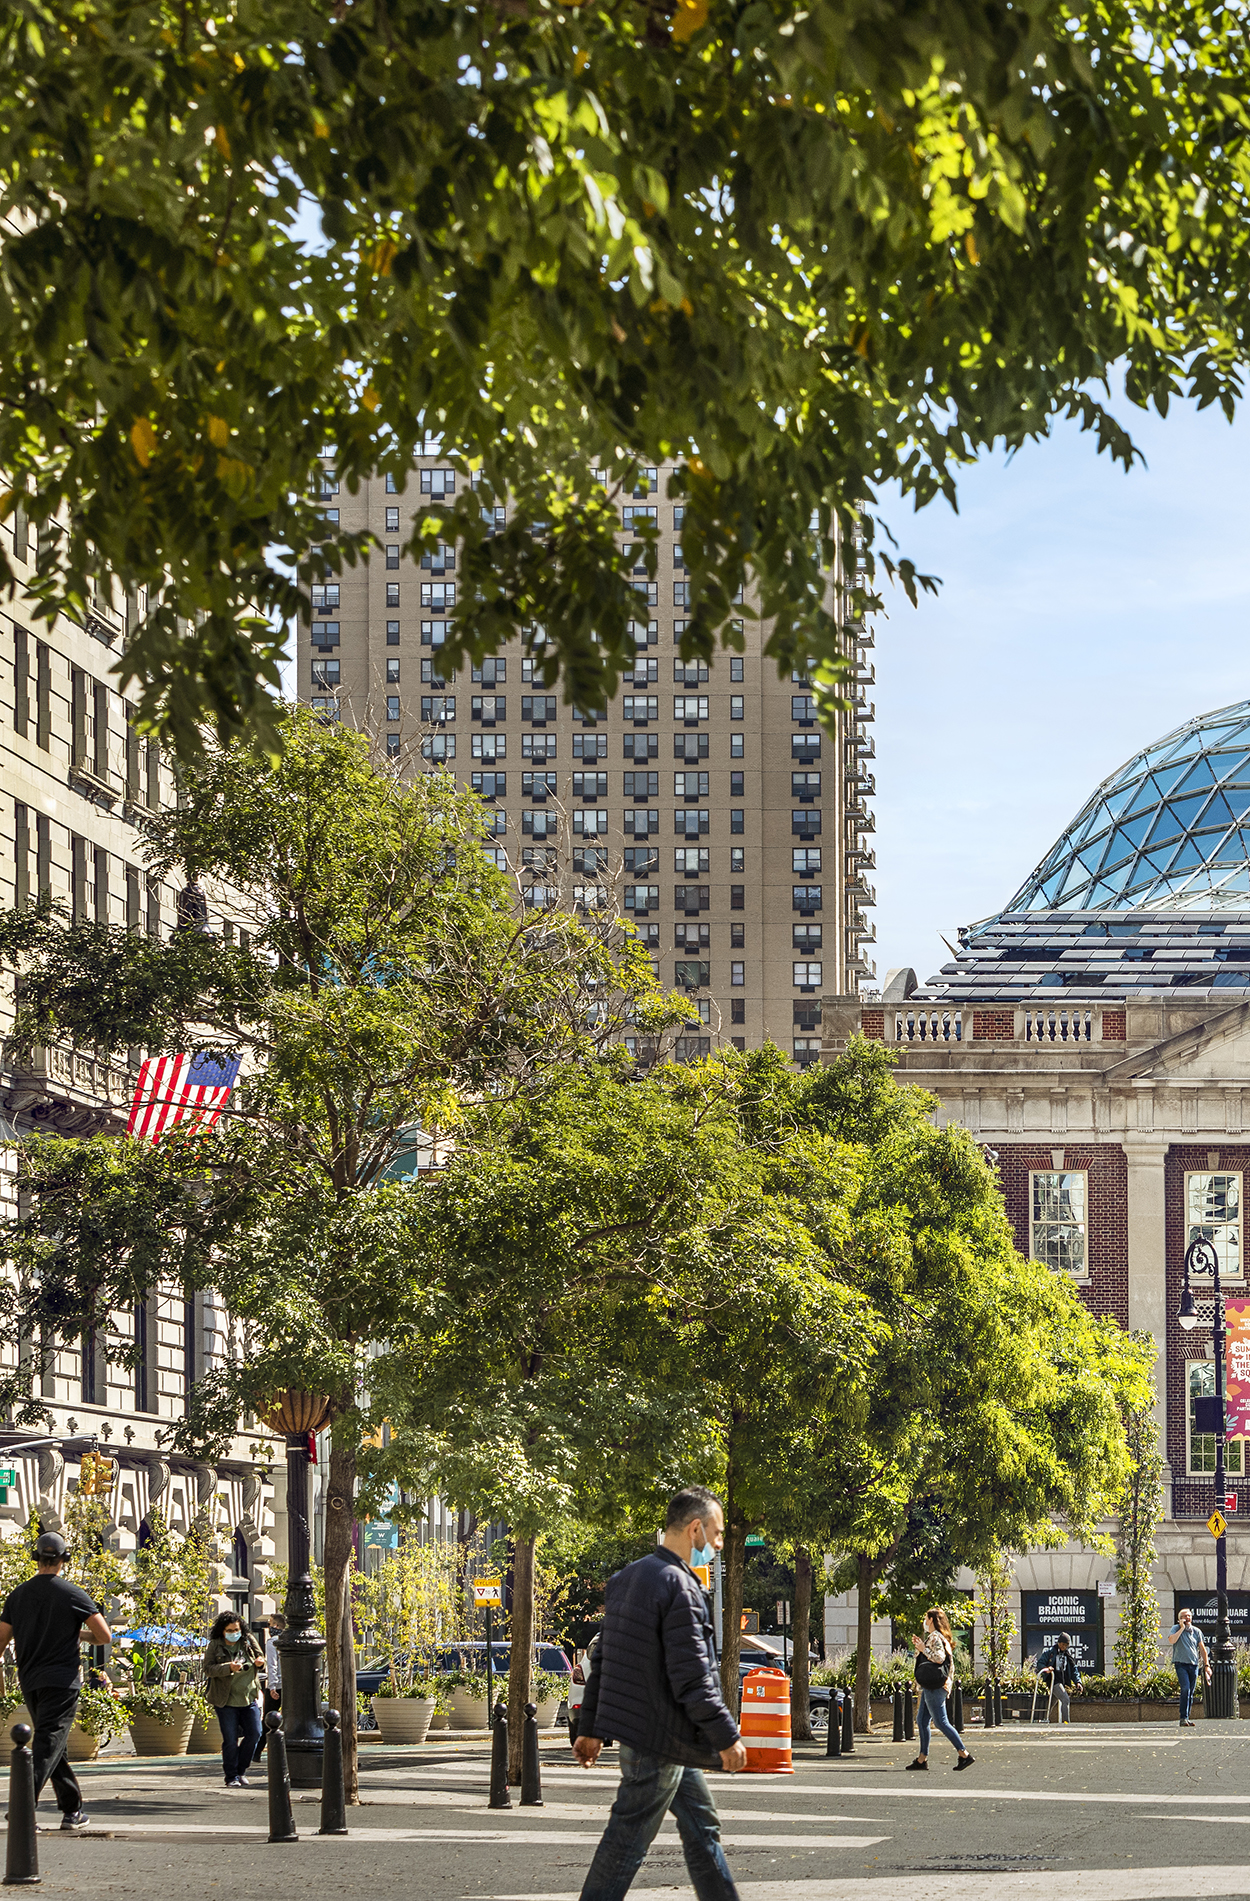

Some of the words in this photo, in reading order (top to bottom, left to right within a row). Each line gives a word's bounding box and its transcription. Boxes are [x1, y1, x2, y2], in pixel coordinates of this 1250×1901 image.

[1048, 1596, 1079, 1605] ICONIC
[1038, 1606, 1085, 1615] BRANDING
[1196, 1608, 1218, 1617] UNION
[1043, 1635, 1083, 1647] REAIL
